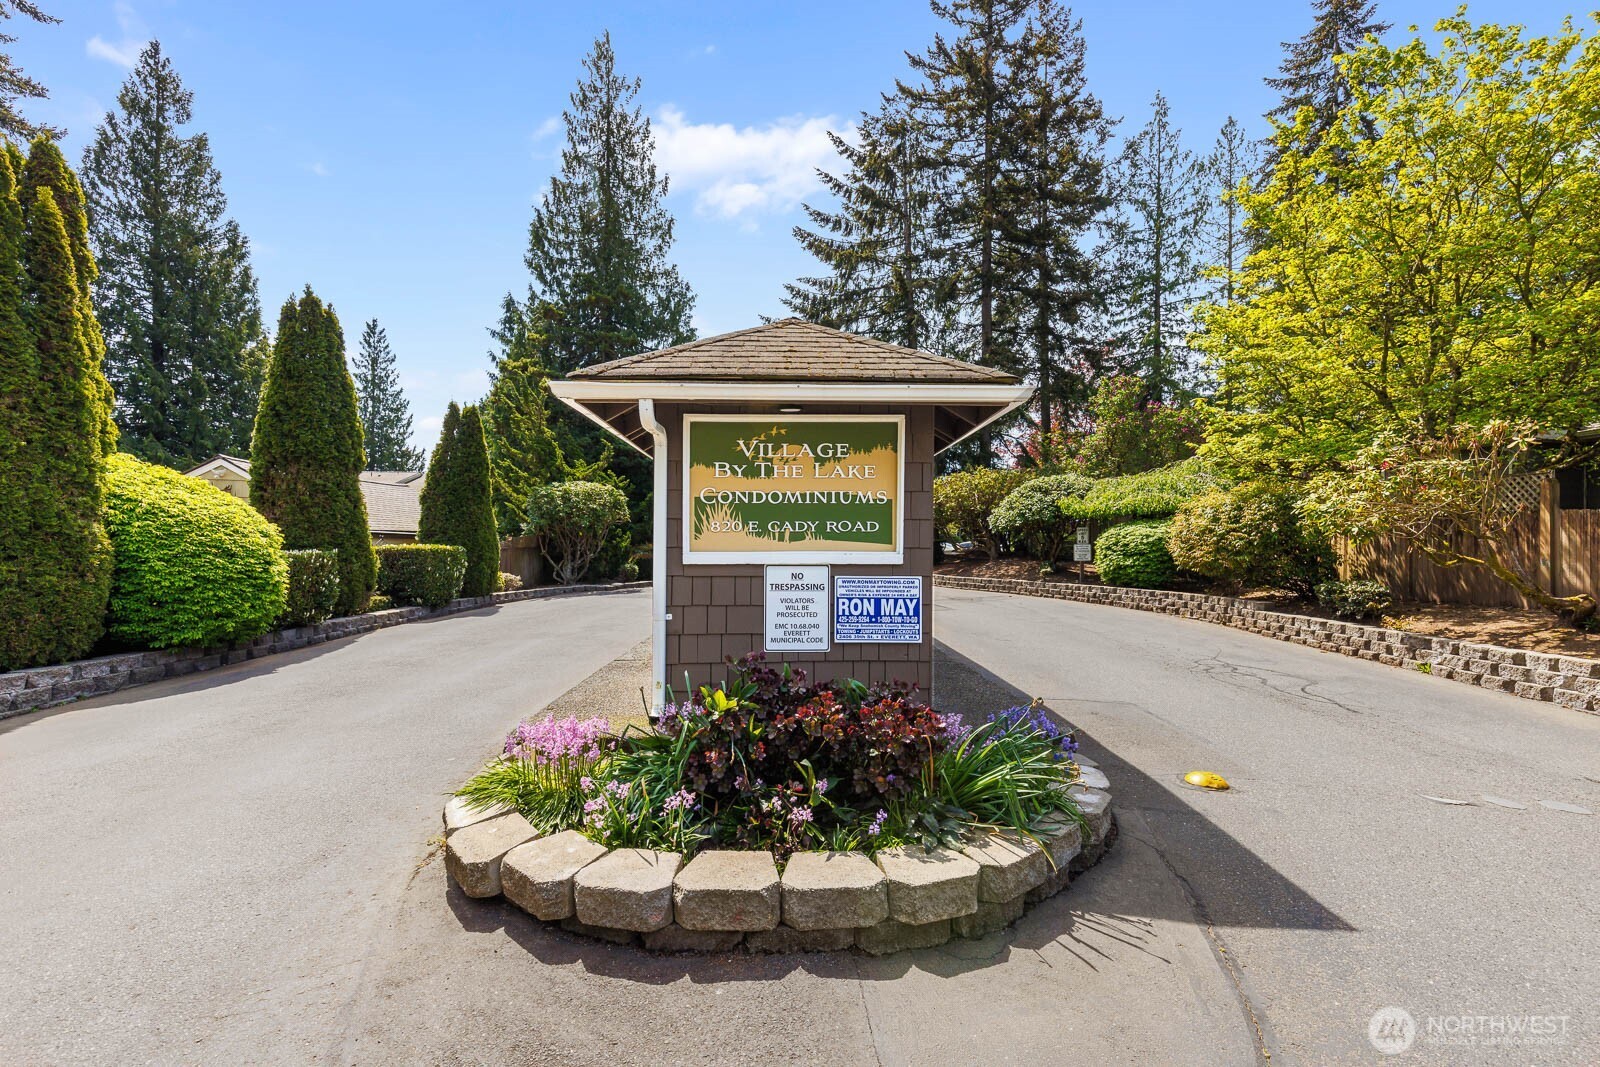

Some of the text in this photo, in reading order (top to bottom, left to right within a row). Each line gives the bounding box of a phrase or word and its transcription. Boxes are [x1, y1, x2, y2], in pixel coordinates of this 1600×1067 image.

[736, 439, 850, 458] VILLAGE
[713, 462, 876, 479] BY THE LAKE
[699, 487, 888, 504] CONDOMINIUMS
[710, 520, 880, 534] 820 E. CADY ROAD
[838, 598, 918, 616] RON MAY
